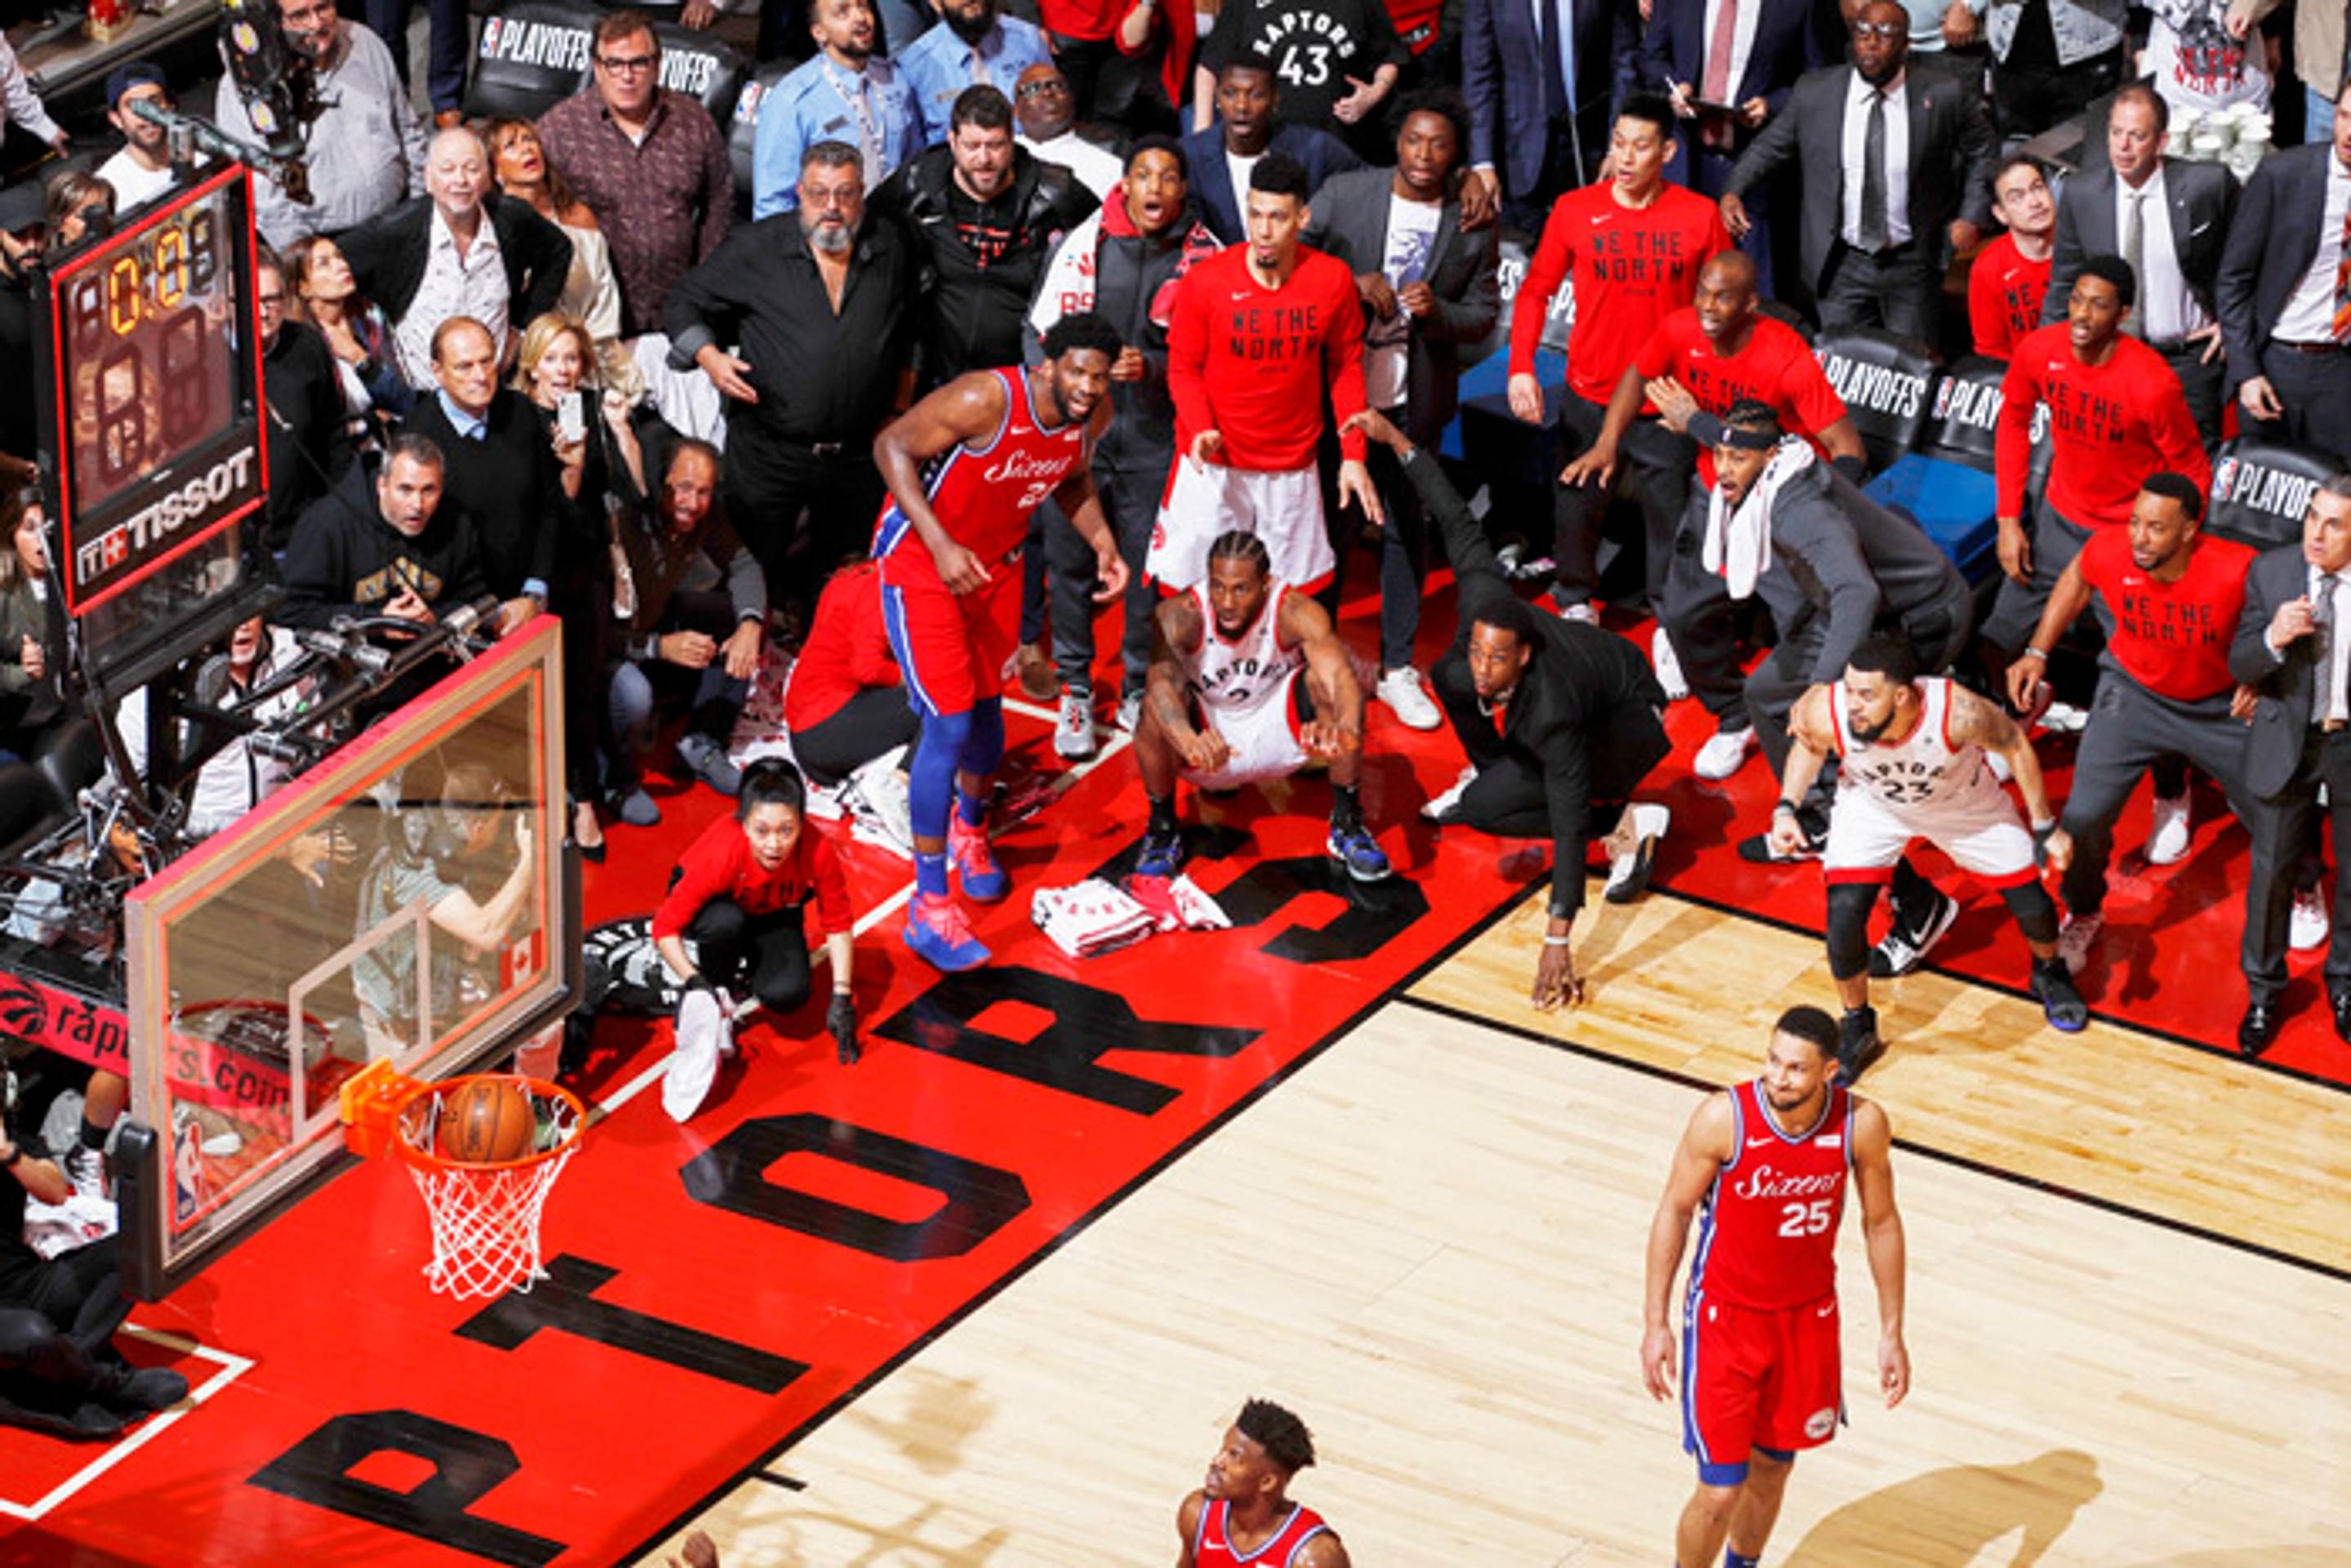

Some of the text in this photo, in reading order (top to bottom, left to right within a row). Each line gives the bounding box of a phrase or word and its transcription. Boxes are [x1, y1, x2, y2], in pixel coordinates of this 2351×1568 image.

[497, 19, 594, 71] PLAYOFFS
[1253, 10, 1356, 58] RAPTORS
[658, 47, 718, 94] YOFFS
[1278, 44, 1329, 86] 43
[1593, 230, 1683, 257] WE THE
[1594, 257, 1684, 283] NORTH
[1231, 305, 1318, 335] WE THE
[1229, 336, 1318, 362] NORTH
[1827, 354, 1926, 418] PLAYOFFS
[2050, 406, 2124, 444] ORTH
[127, 446, 255, 550] TISSOT
[2232, 462, 2322, 522] PLAYOF
[2122, 617, 2217, 645] NORTH
[2166, 602, 2215, 627] THE
[1880, 779, 1934, 804] 23
[1734, 1165, 1842, 1200] Sixers
[1778, 1197, 1834, 1238] 25
